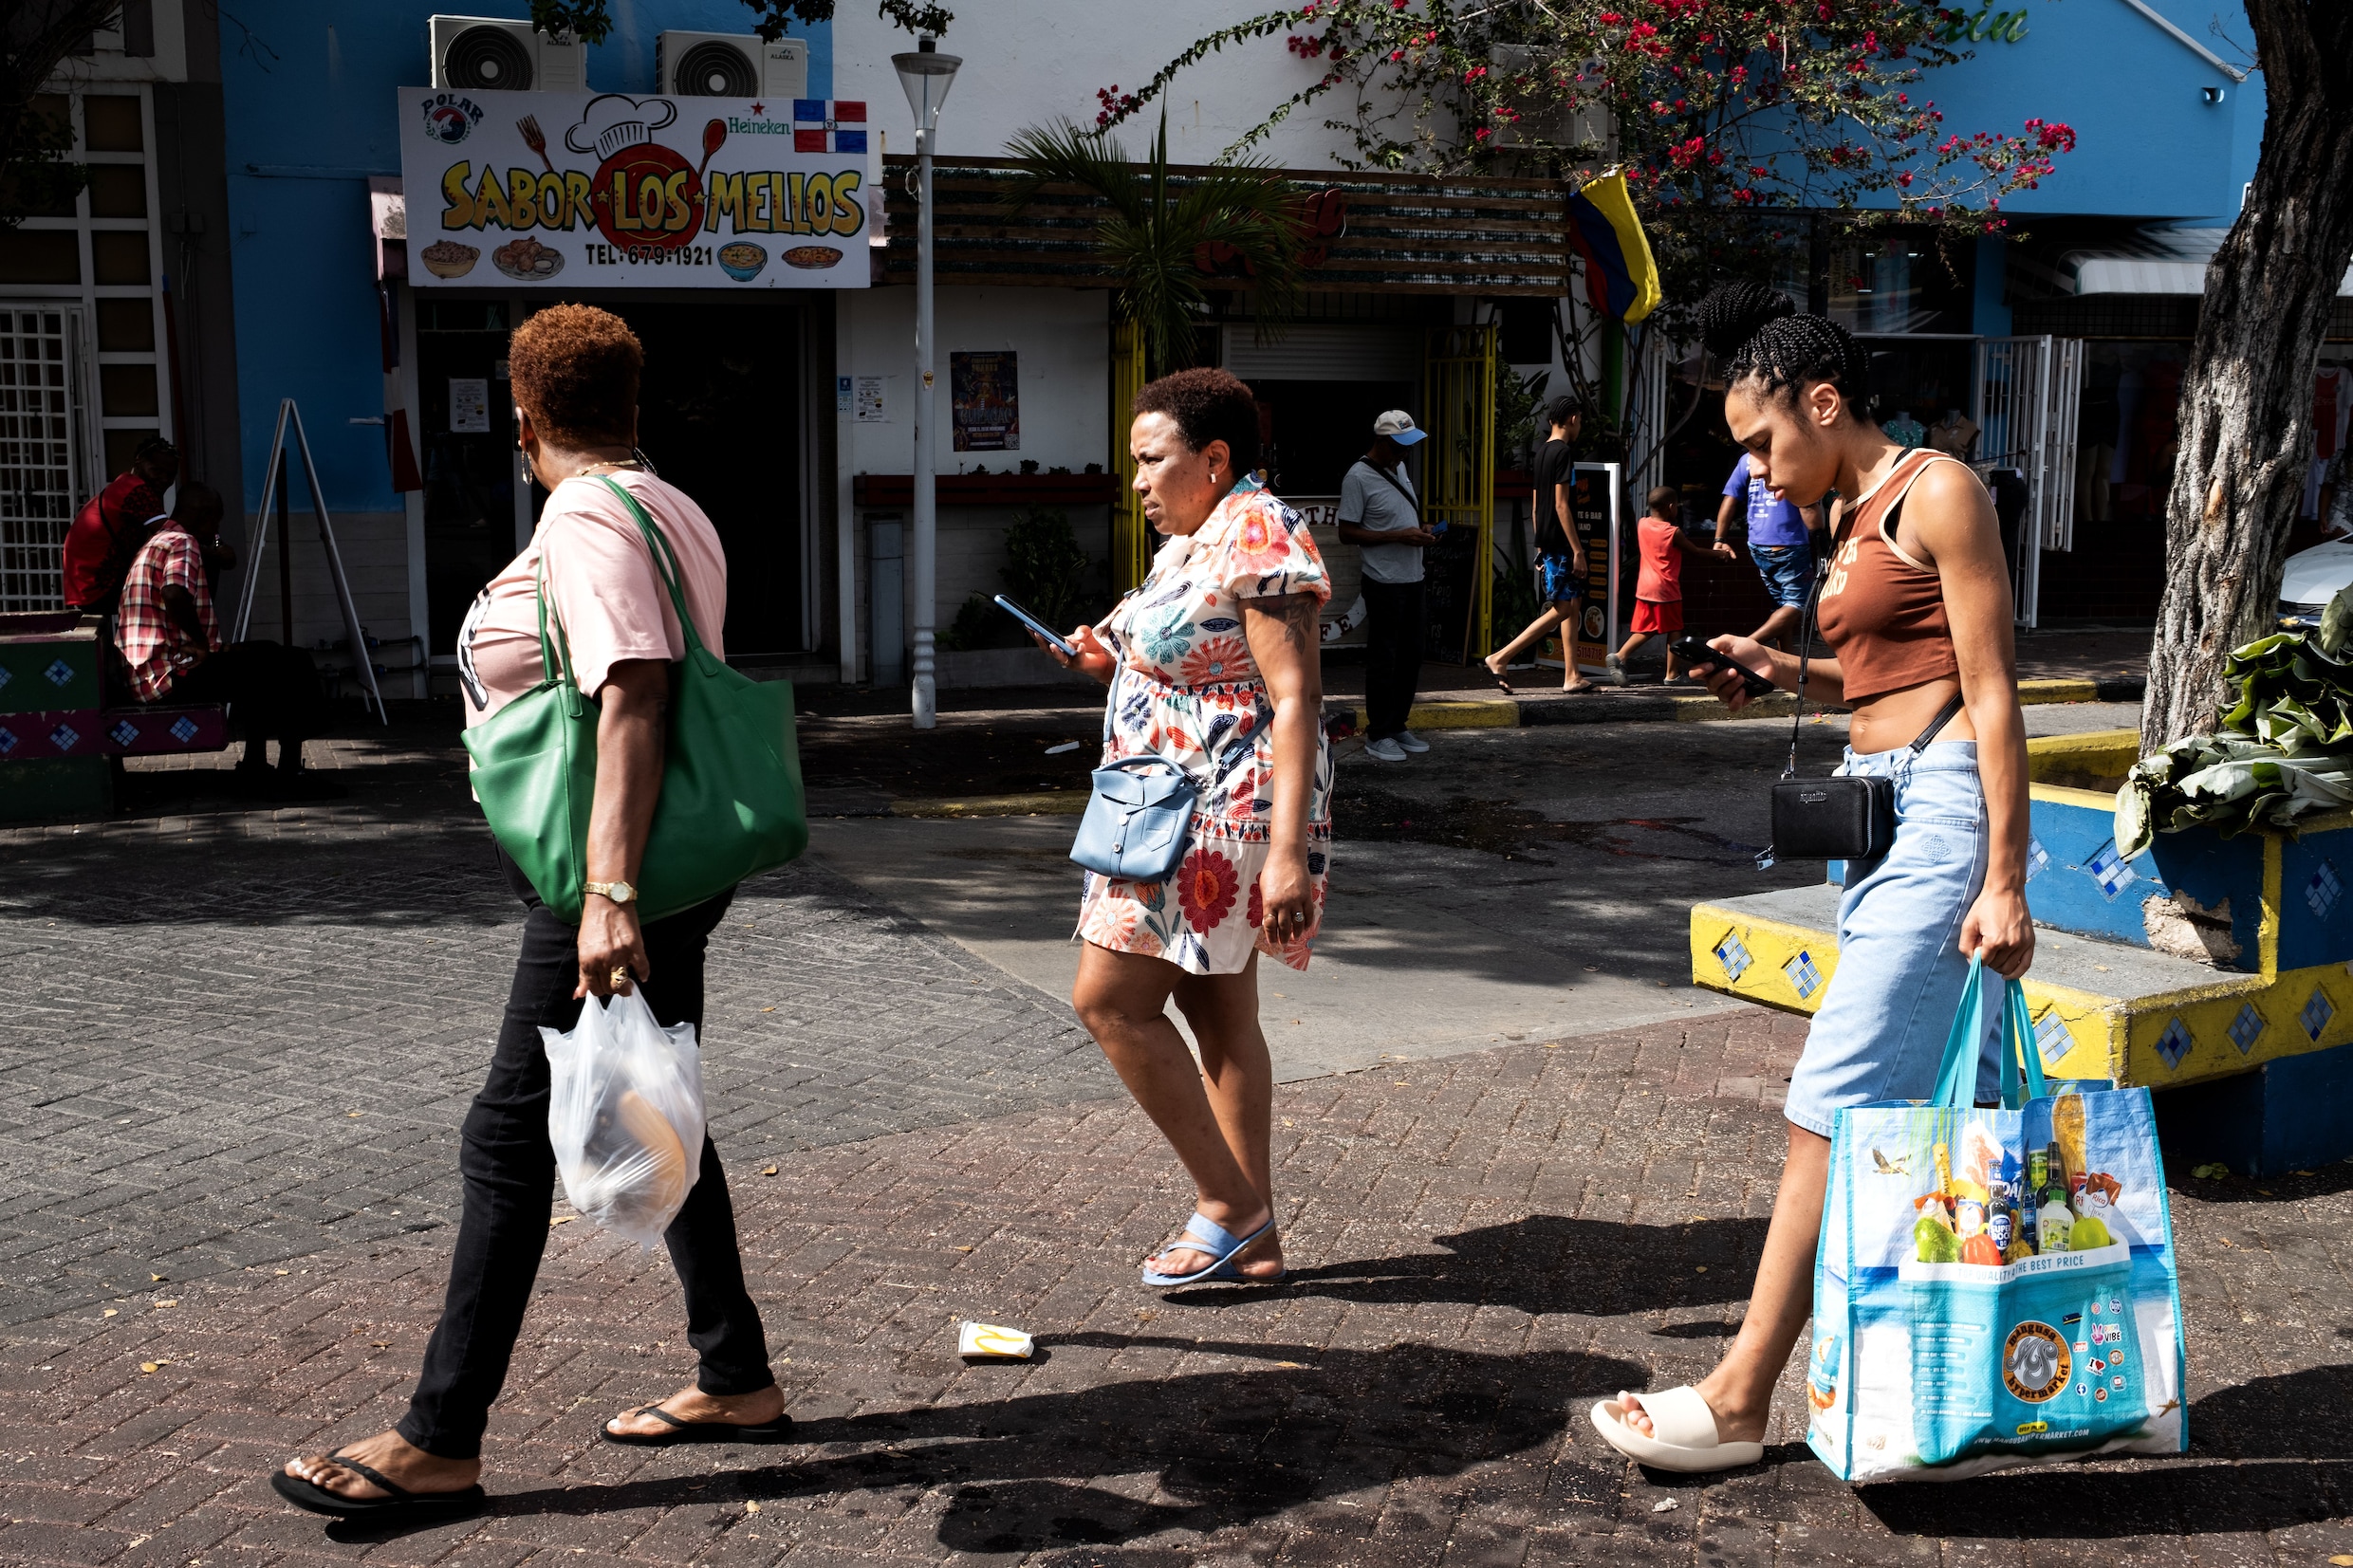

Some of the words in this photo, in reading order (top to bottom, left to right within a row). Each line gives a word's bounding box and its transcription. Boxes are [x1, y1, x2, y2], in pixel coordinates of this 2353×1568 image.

[420, 93, 484, 126] POLAR
[728, 117, 791, 135] Heineken
[441, 159, 598, 231] SABOR
[614, 167, 692, 232] LOS
[704, 169, 865, 237] MELLOS
[2030, 1258, 2052, 1272] BEST
[2057, 1255, 2084, 1268] PRICE
[2009, 1323, 2057, 1347] mangusa
[2104, 1332, 2121, 1341] VIBE
[2008, 1364, 2069, 1399] hypermarket
